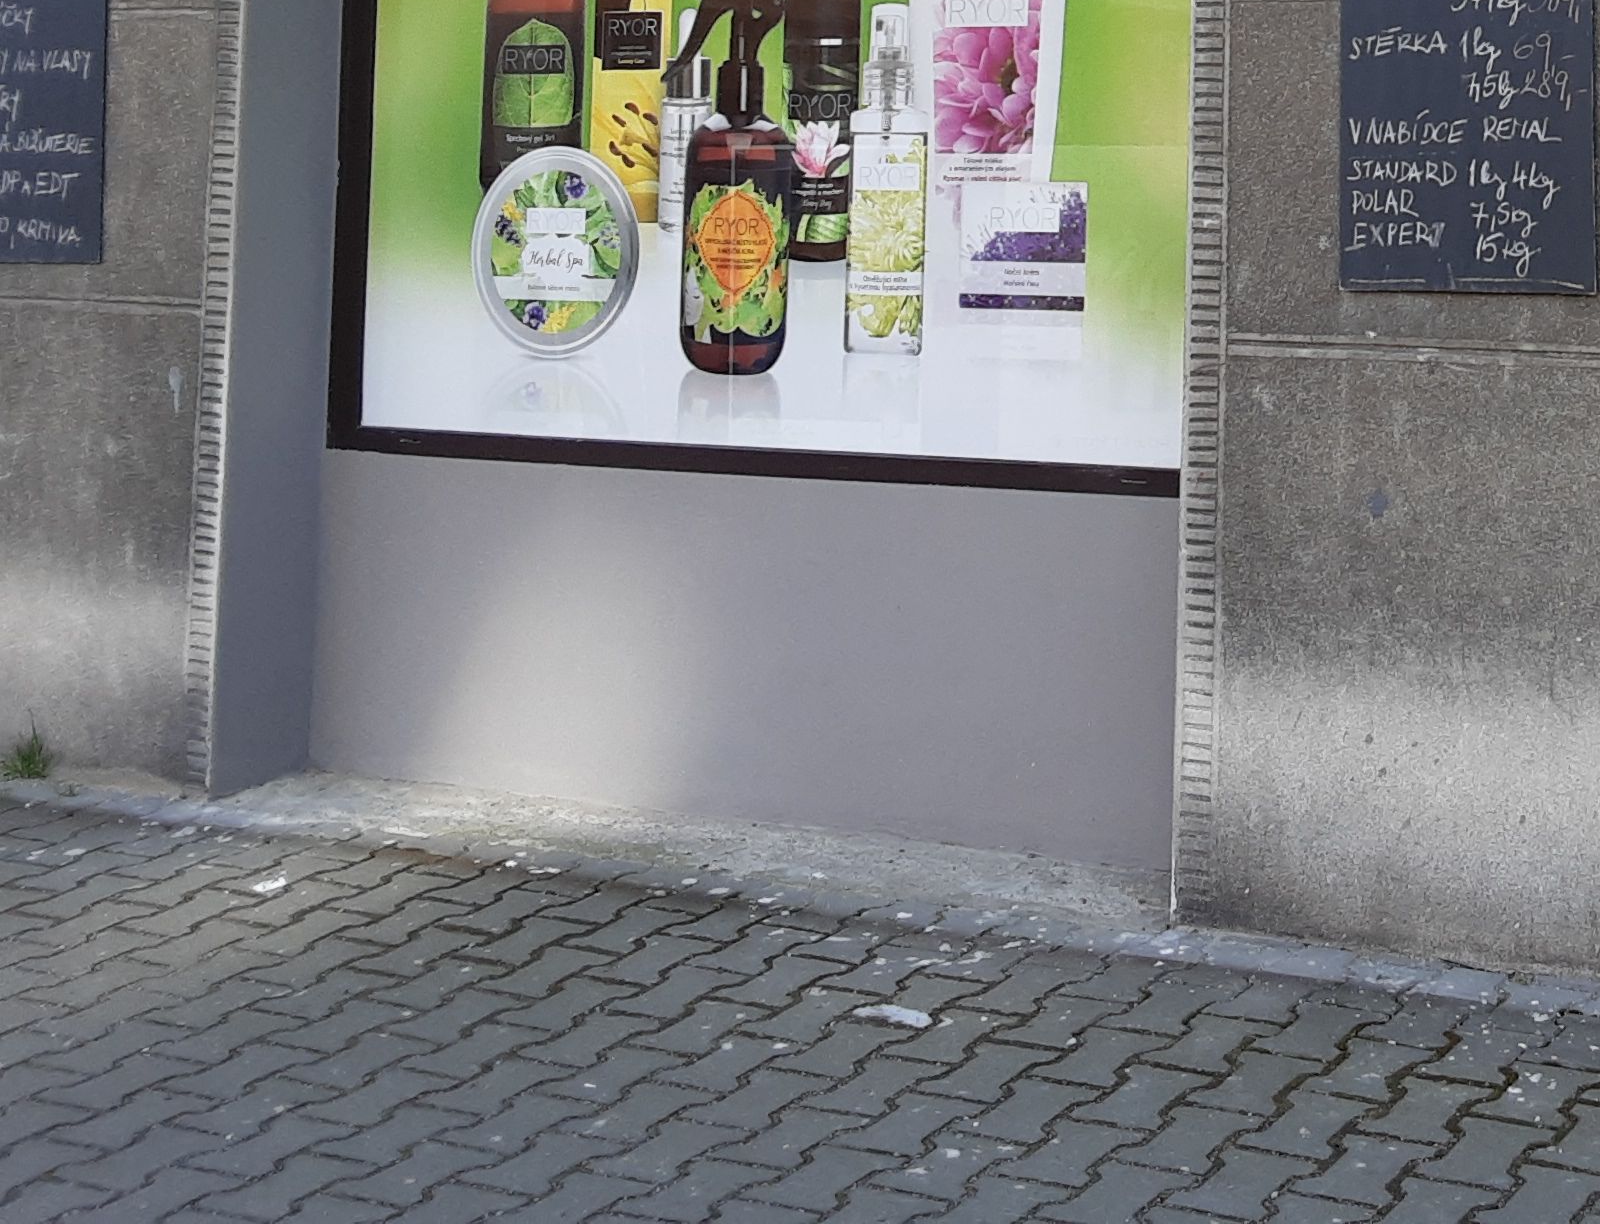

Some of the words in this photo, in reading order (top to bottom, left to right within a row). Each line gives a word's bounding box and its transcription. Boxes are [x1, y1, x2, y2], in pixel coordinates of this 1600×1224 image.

[608, 18, 657, 36] RYOR
[504, 49, 564, 71] RYOR
[790, 93, 851, 118] RYOR
[1365, 109, 1468, 144] NABÍDCE
[1347, 159, 1457, 186] STANDARD
[1352, 189, 1419, 217] POLAR
[714, 217, 760, 236] RYOR
